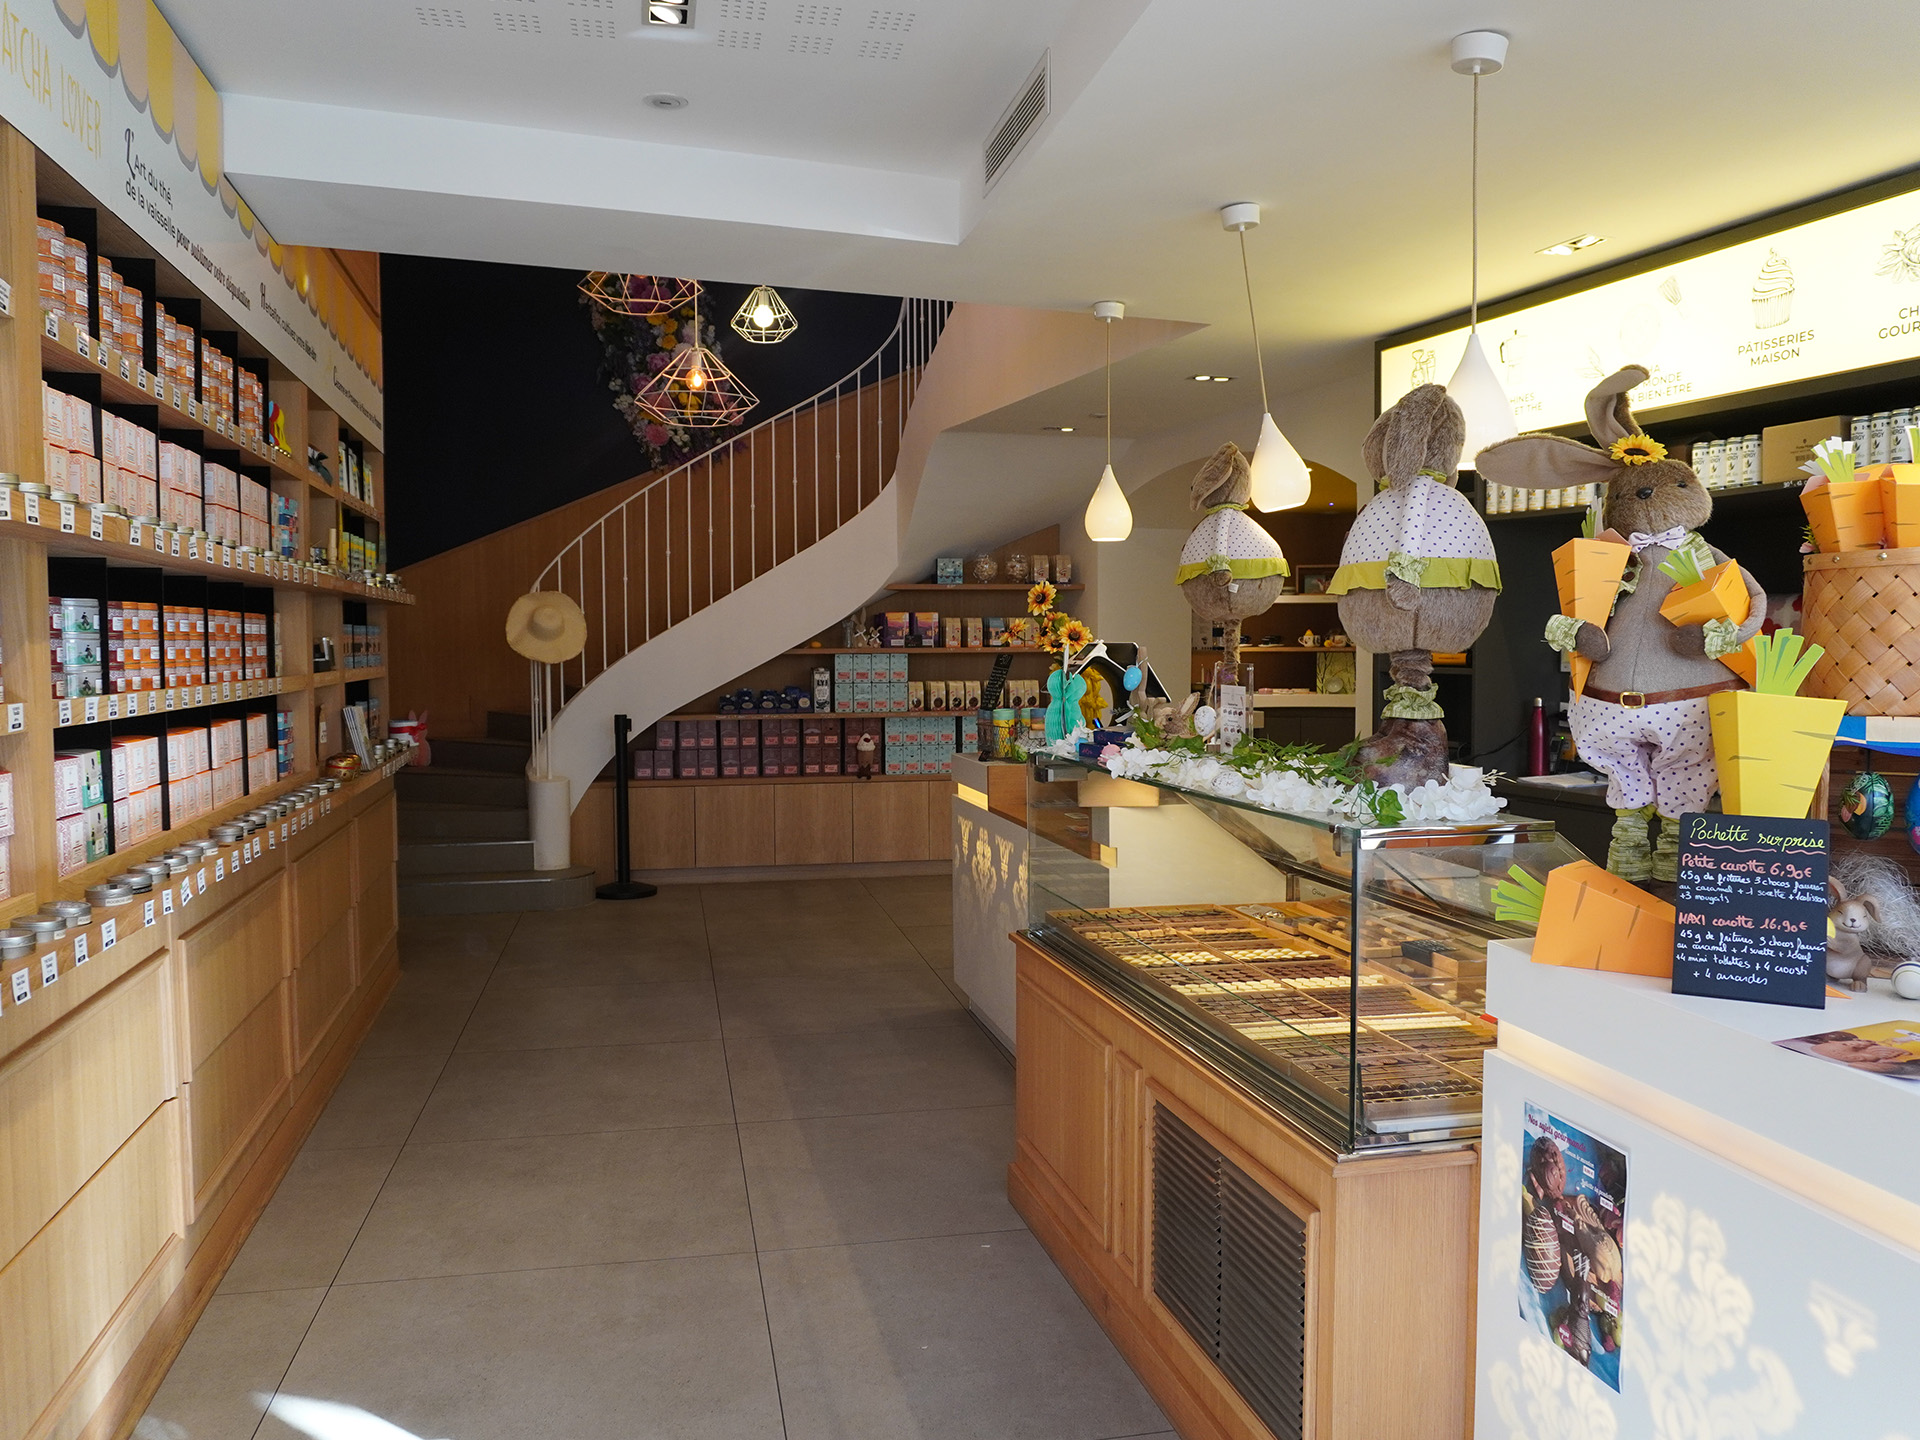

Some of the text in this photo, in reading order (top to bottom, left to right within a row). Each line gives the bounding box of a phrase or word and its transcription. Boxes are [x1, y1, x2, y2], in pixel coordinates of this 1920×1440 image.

[60, 63, 102, 160] LOVER
[148, 168, 158, 192] du
[159, 180, 174, 211] thé,
[125, 178, 137, 201] de
[137, 186, 145, 209] la
[146, 199, 176, 239] vaisselle
[176, 227, 190, 252] pour
[1878, 320, 1920, 340] GOUR
[1738, 329, 1815, 355] PÂTISSERIES
[1750, 347, 1800, 367] MAISON
[1642, 371, 1682, 388] MONDE
[1689, 817, 1826, 852] Pochette surprise
[1682, 852, 1813, 880] Petite carotte 6,90€
[1695, 884, 1733, 894] caramel
[1695, 893, 1730, 905] nougats
[1678, 912, 1706, 926] MAXI
[1712, 915, 1755, 929] carotte
[1692, 942, 1728, 953] caramel
[1705, 930, 1715, 941] de
[1719, 931, 1754, 946] fritures
[1768, 935, 1795, 948] chocos
[1688, 953, 1708, 963] mini
[1713, 954, 1751, 969] tablettes
[1763, 961, 1771, 971] 4
[1705, 968, 1711, 978] 4
[1716, 972, 1768, 985] amandes
[1528, 1113, 1538, 1127] Nos
[1554, 1130, 1587, 1153] gourmands
